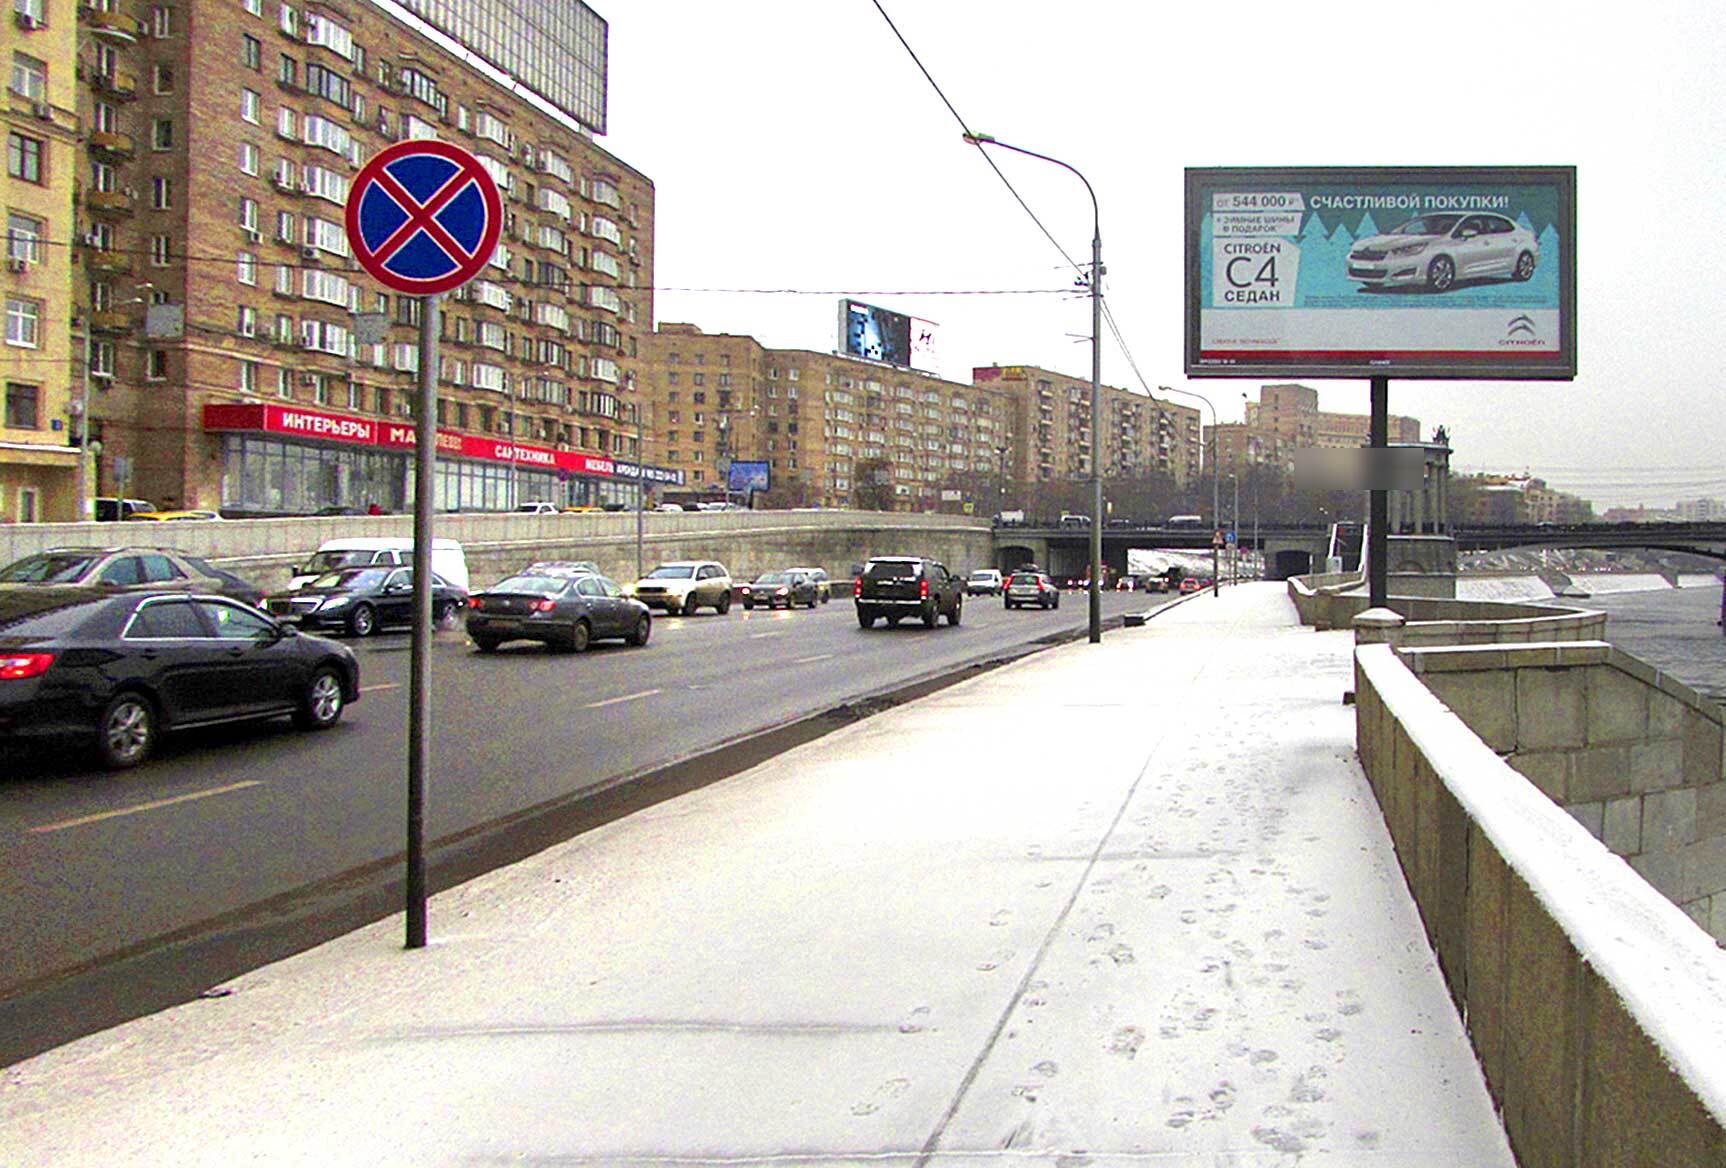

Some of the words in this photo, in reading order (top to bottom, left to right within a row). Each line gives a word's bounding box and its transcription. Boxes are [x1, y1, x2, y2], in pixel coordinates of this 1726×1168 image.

[1232, 195, 1257, 207] 544
[1261, 195, 1286, 207] 000
[1310, 193, 1420, 209] СЧАСТЛИВОЙ
[1424, 195, 1509, 209] ПОКУПКИ!
[1226, 256, 1279, 288] C4
[1224, 290, 1280, 303] СЕДАН
[282, 412, 370, 438] ИНТЕРЬЕРЫ
